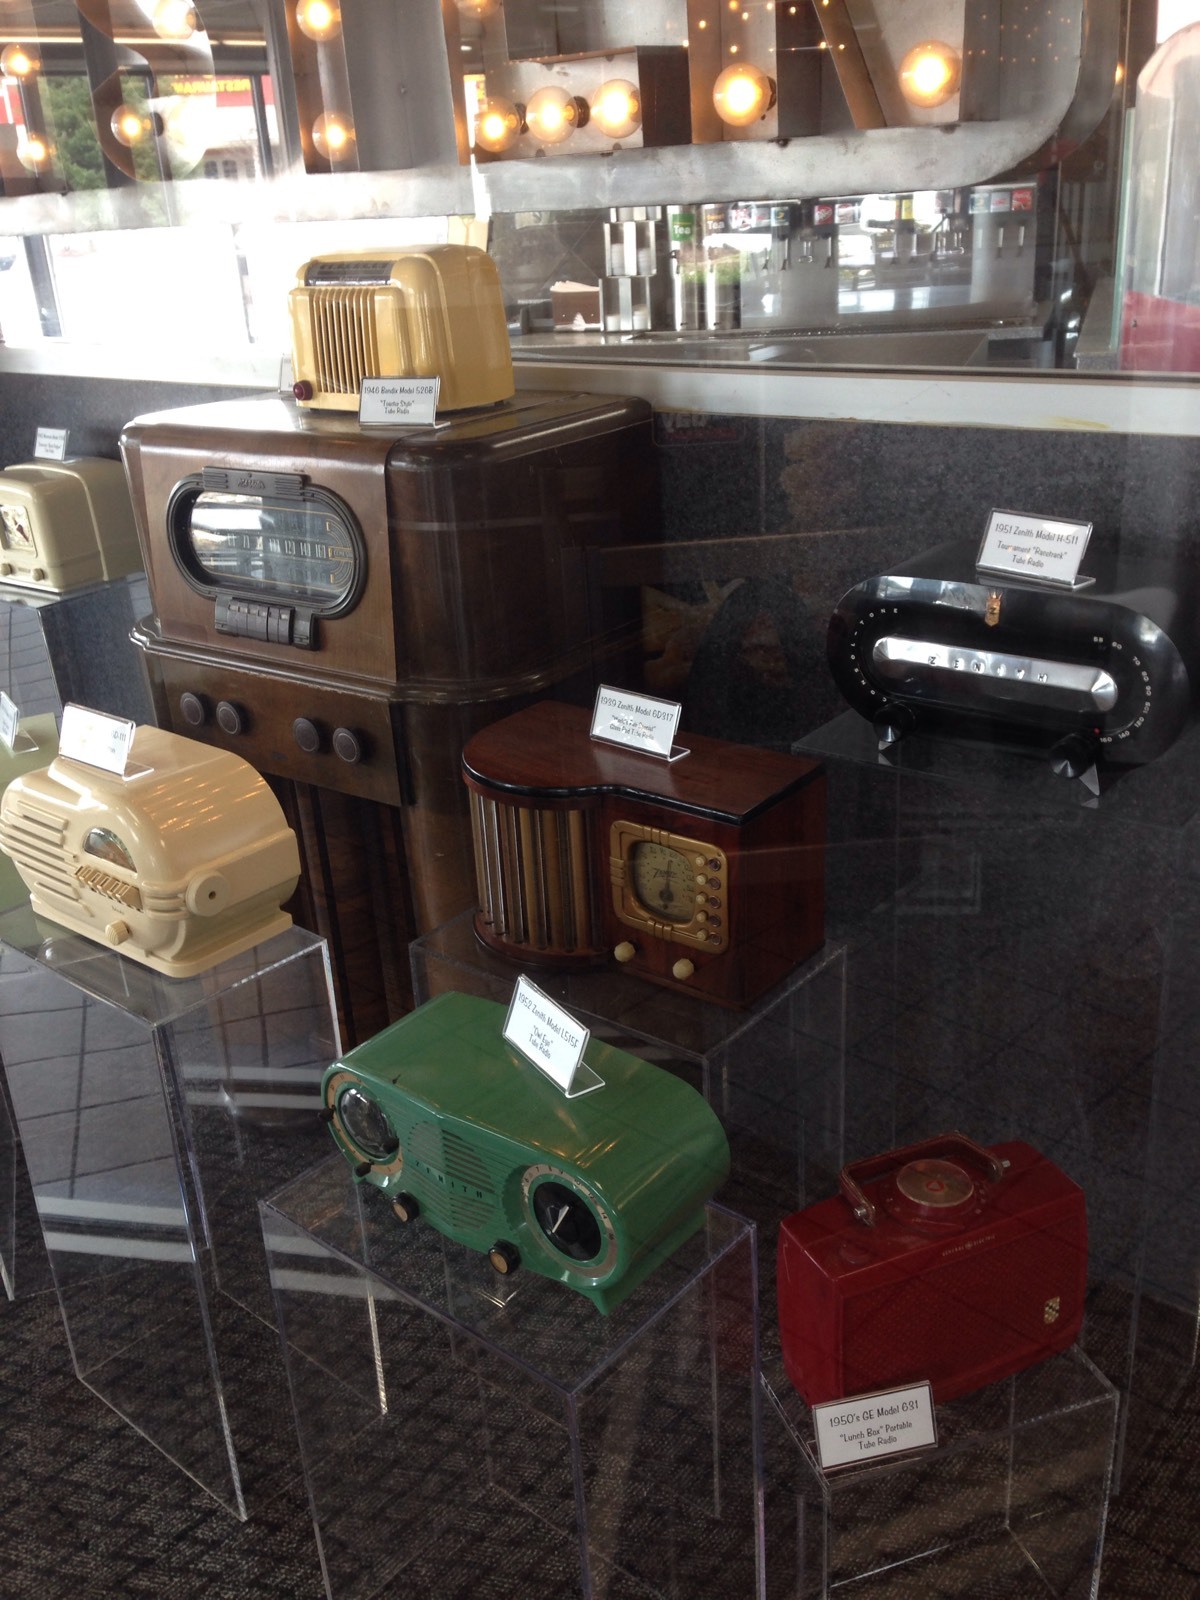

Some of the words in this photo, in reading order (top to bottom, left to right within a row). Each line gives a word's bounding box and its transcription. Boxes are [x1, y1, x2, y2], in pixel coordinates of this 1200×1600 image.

[673, 225, 691, 235] Tea
[707, 221, 725, 230] Tea
[400, 386, 415, 394] Model
[995, 523, 1012, 534] 1951
[1013, 526, 1034, 538] Zenith
[1035, 530, 1056, 541] Model
[1057, 534, 1079, 545] H-511
[1012, 554, 1026, 565] Tube
[1027, 557, 1044, 568] Radio
[617, 701, 634, 712] Zenith
[635, 705, 652, 717] Model
[518, 992, 533, 1010] 1952
[531, 1003, 547, 1023] Zenith
[546, 1016, 562, 1034] Model
[528, 1033, 539, 1049] Tube
[539, 1042, 551, 1059] Radio
[829, 1413, 861, 1427] 1950's
[862, 1409, 875, 1421] GE
[877, 1404, 900, 1418] Model
[901, 1399, 919, 1413] 631
[839, 1431, 865, 1443] "Lunch
[866, 1425, 884, 1437] Box"
[885, 1421, 913, 1433] Portable
[858, 1440, 876, 1450] Tube
[877, 1436, 898, 1446] Radio
